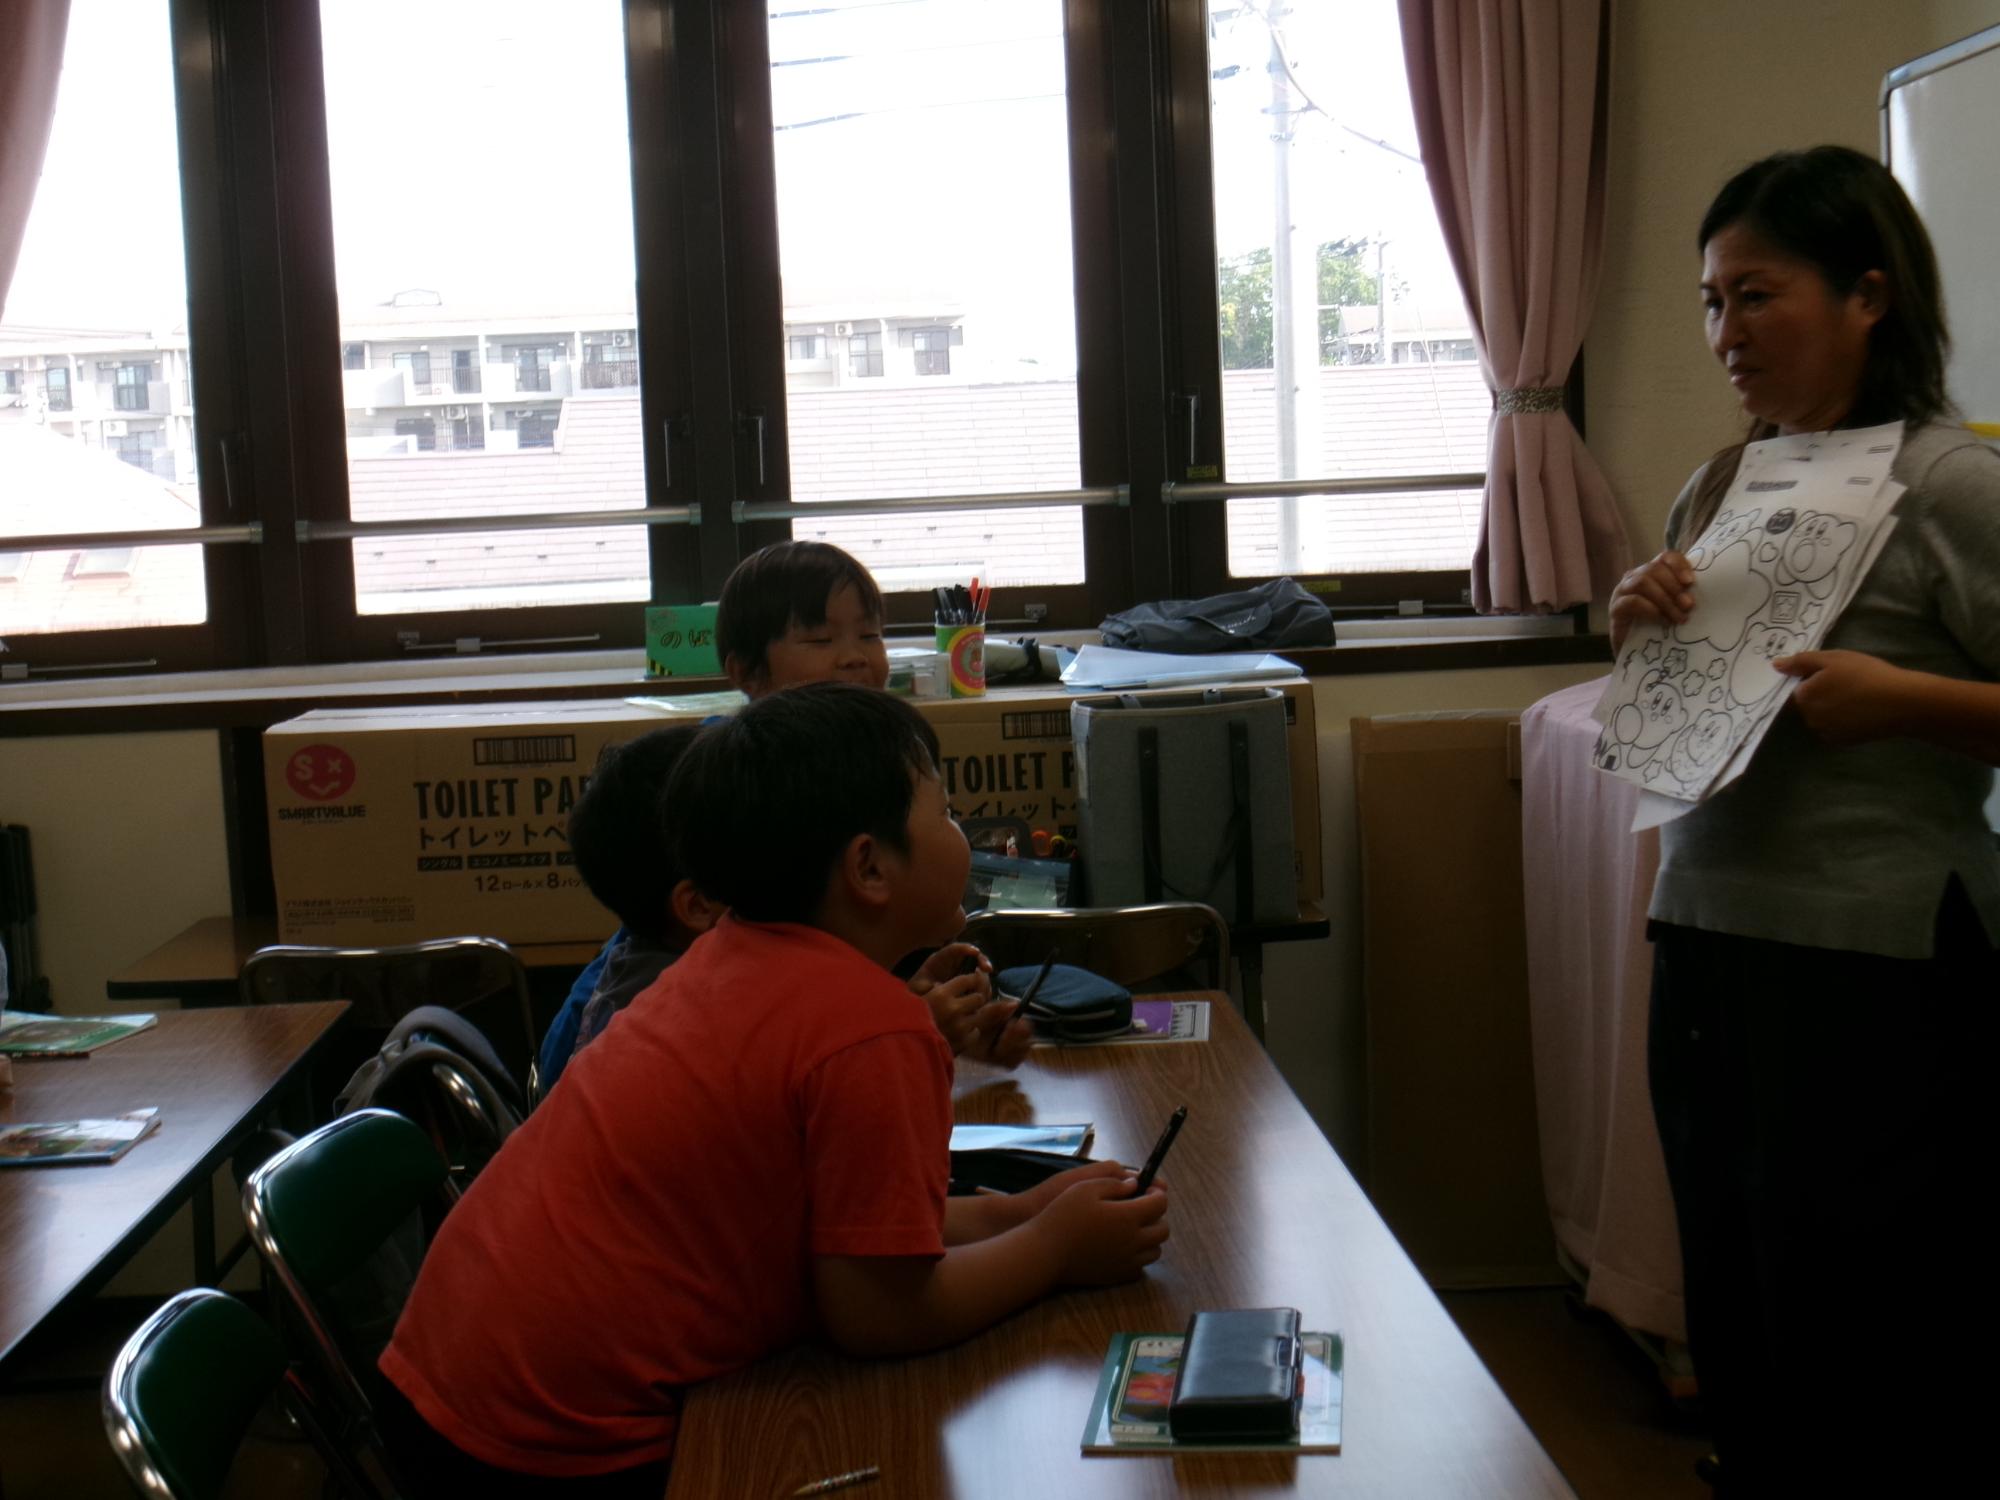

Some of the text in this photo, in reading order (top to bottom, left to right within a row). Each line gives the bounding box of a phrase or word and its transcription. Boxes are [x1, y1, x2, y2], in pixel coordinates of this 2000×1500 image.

[942, 752, 1047, 794] TOILET
[278, 804, 367, 820] SMARTVALUE
[413, 778, 519, 819] TOILET
[474, 872, 587, 893] 12ロール×8パッ
